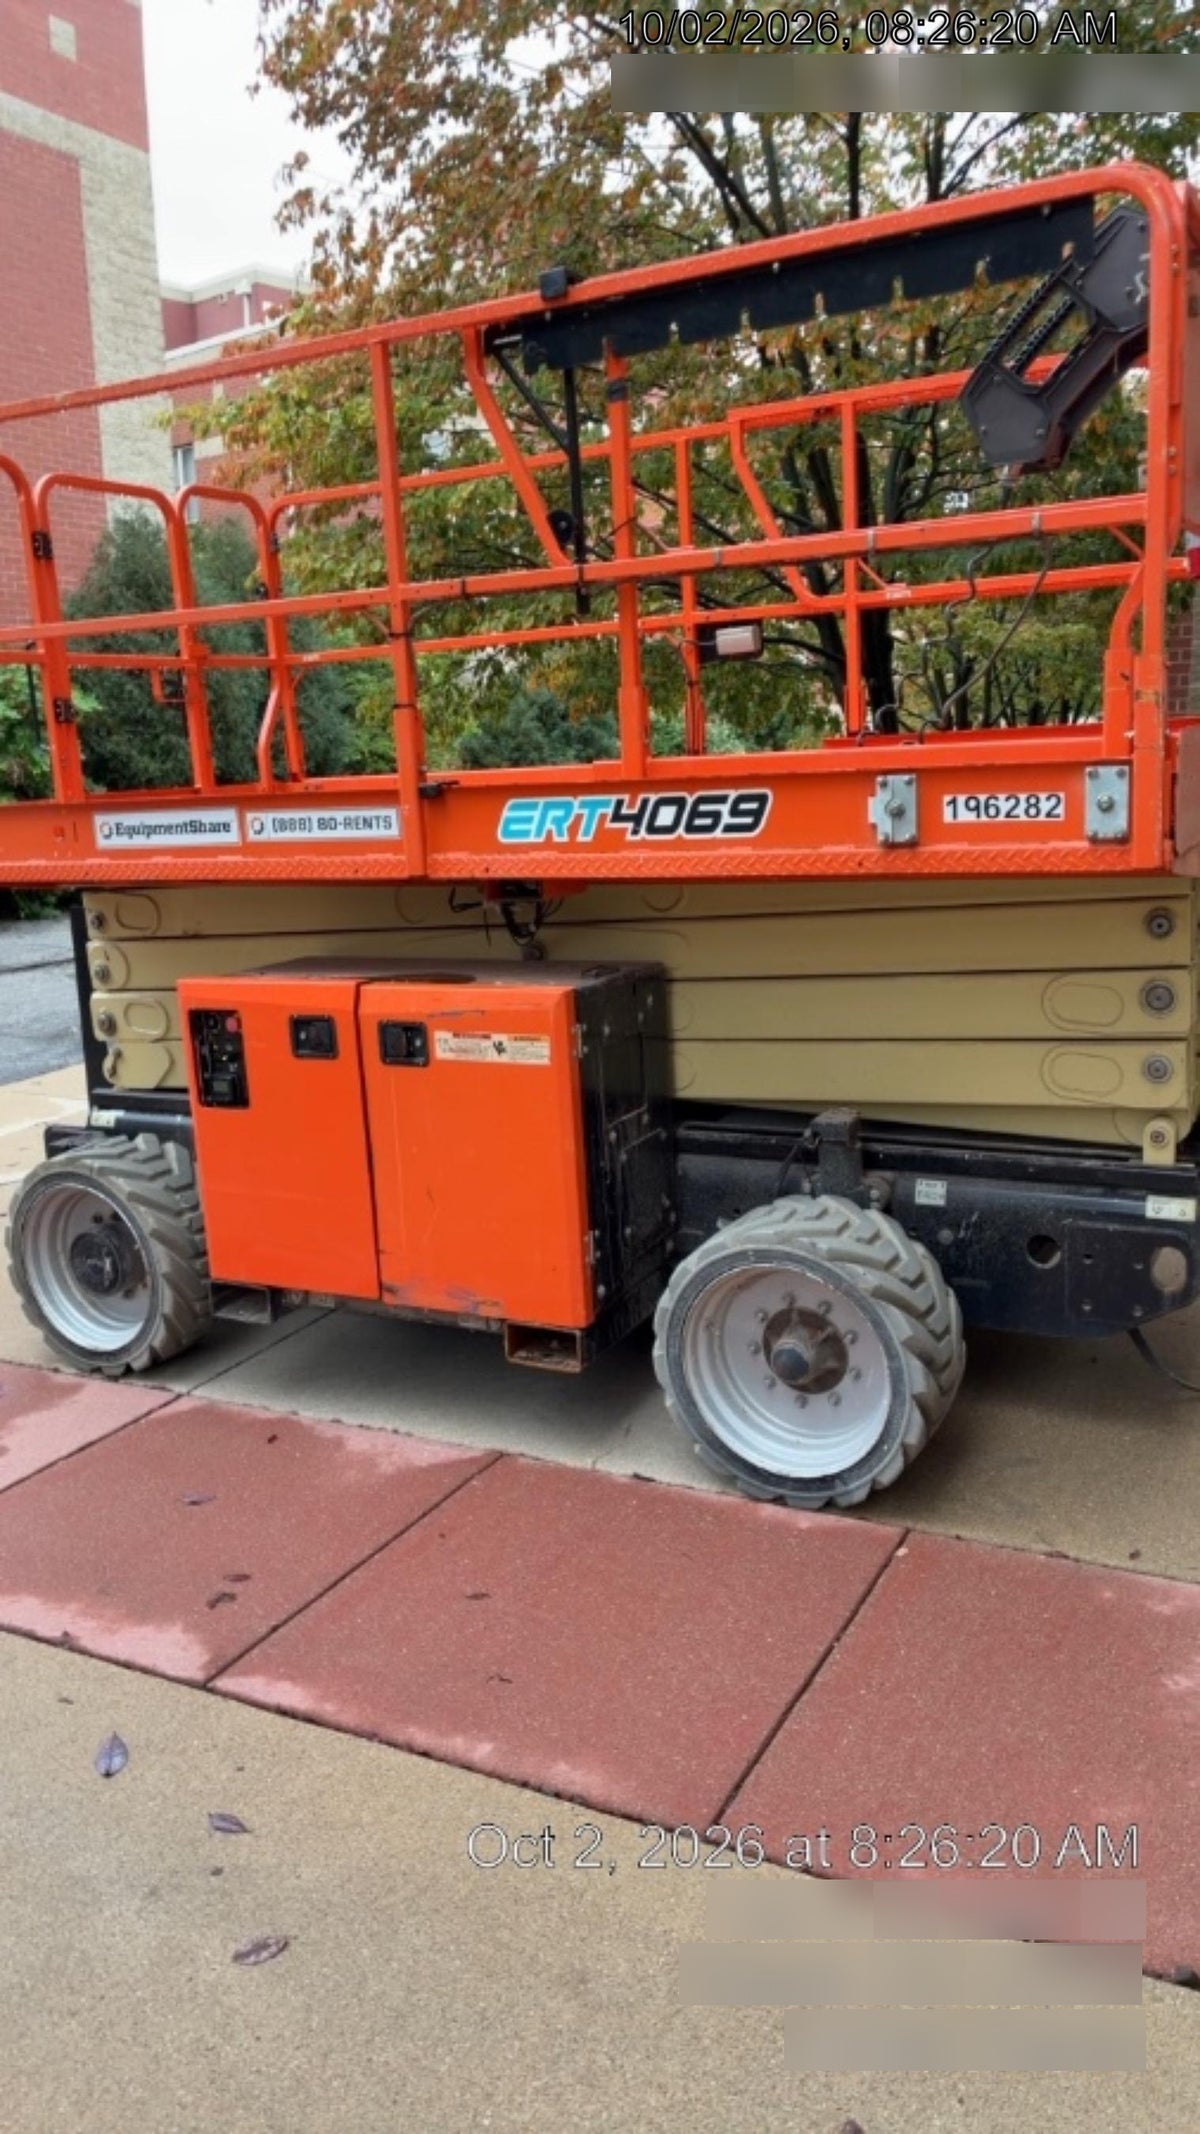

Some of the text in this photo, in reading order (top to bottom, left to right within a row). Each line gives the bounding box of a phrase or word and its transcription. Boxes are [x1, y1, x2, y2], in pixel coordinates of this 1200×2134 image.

[945, 794, 1062, 820] 196282
[115, 820, 231, 839] EquipmentShare
[272, 817, 312, 833] (888)
